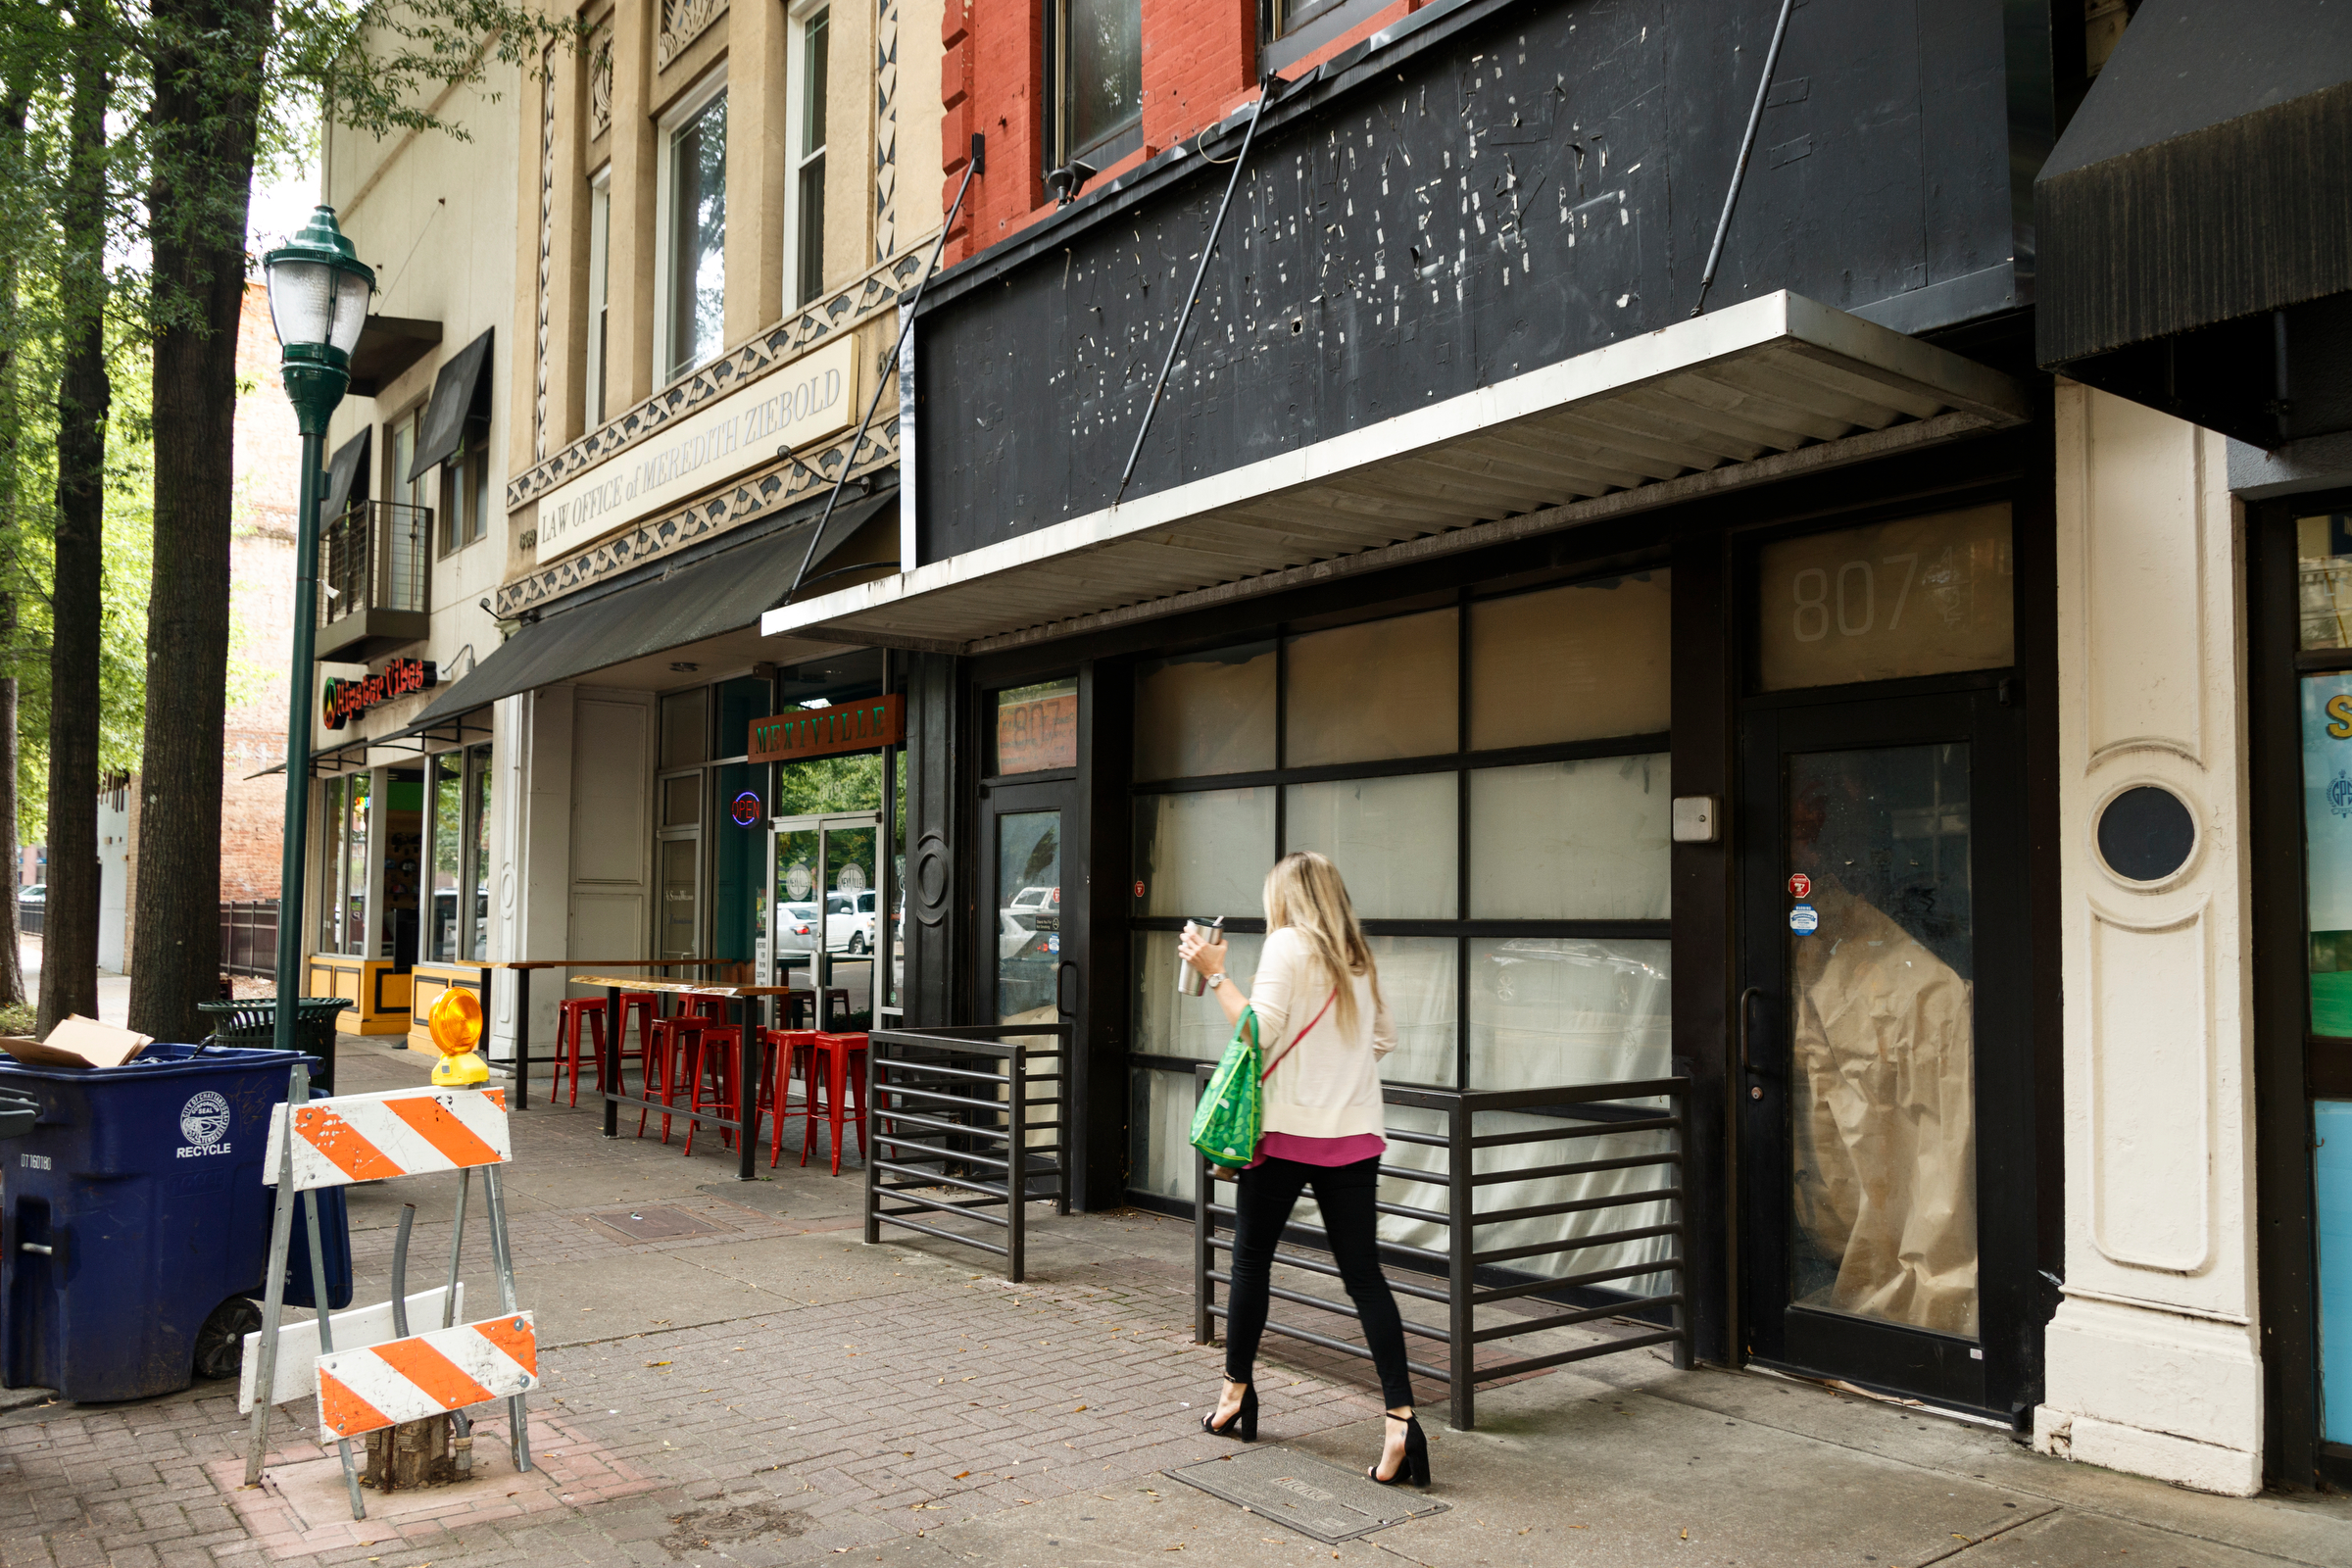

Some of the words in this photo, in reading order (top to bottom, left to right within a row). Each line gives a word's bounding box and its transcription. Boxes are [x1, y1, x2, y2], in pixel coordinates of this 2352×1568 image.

[541, 502, 570, 544] LAW
[572, 474, 623, 527] OFFICE
[625, 465, 641, 502] of
[642, 415, 740, 494] MEREDITH
[742, 368, 841, 447] ZIEBOLD
[1792, 552, 1919, 643] 807
[336, 675, 383, 720] Hipster
[385, 658, 423, 697] Vibes
[756, 706, 886, 755] MEXIVILLE
[1013, 701, 1059, 752] 807
[731, 800, 760, 819] OPEN
[176, 1143, 231, 1158] RECYCLE
